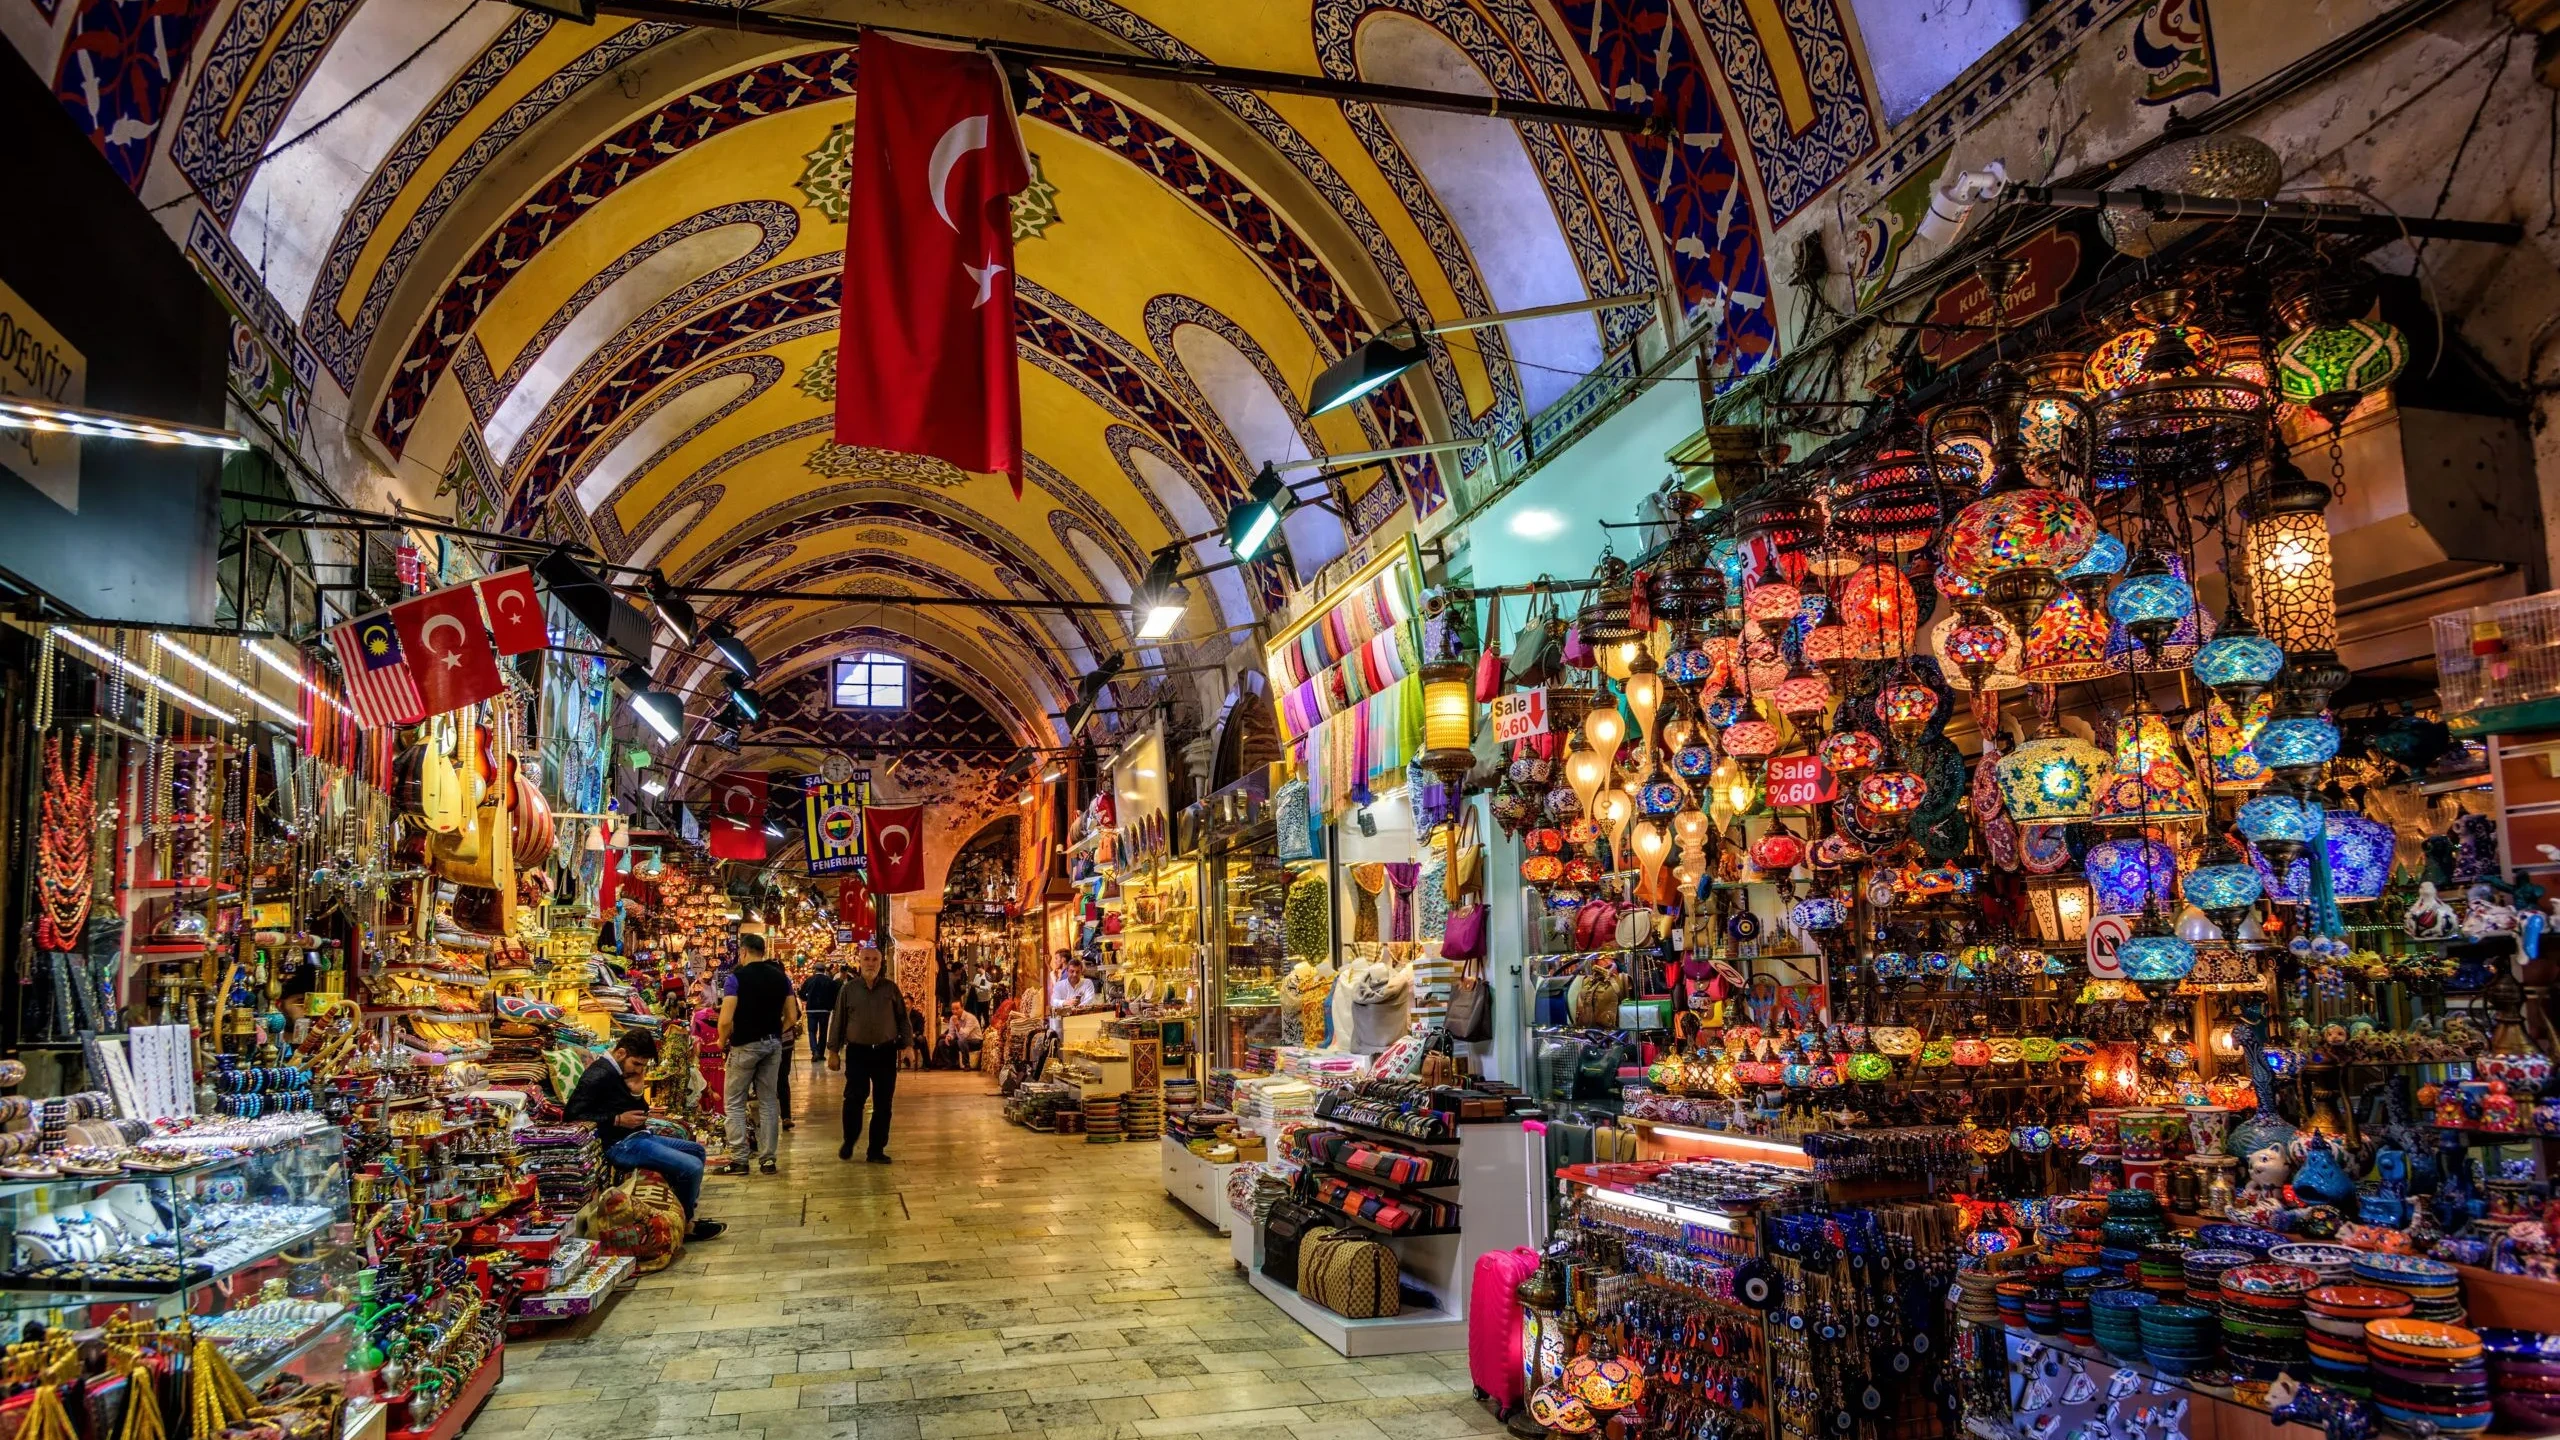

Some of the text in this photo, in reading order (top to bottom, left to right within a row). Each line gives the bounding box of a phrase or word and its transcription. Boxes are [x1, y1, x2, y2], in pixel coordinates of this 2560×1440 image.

[0, 312, 73, 403] DENİZ
[1495, 697, 1527, 717] Sale
[1495, 716, 1529, 740] %60
[1770, 761, 1816, 780] Sale
[1769, 782, 1816, 804] %60
